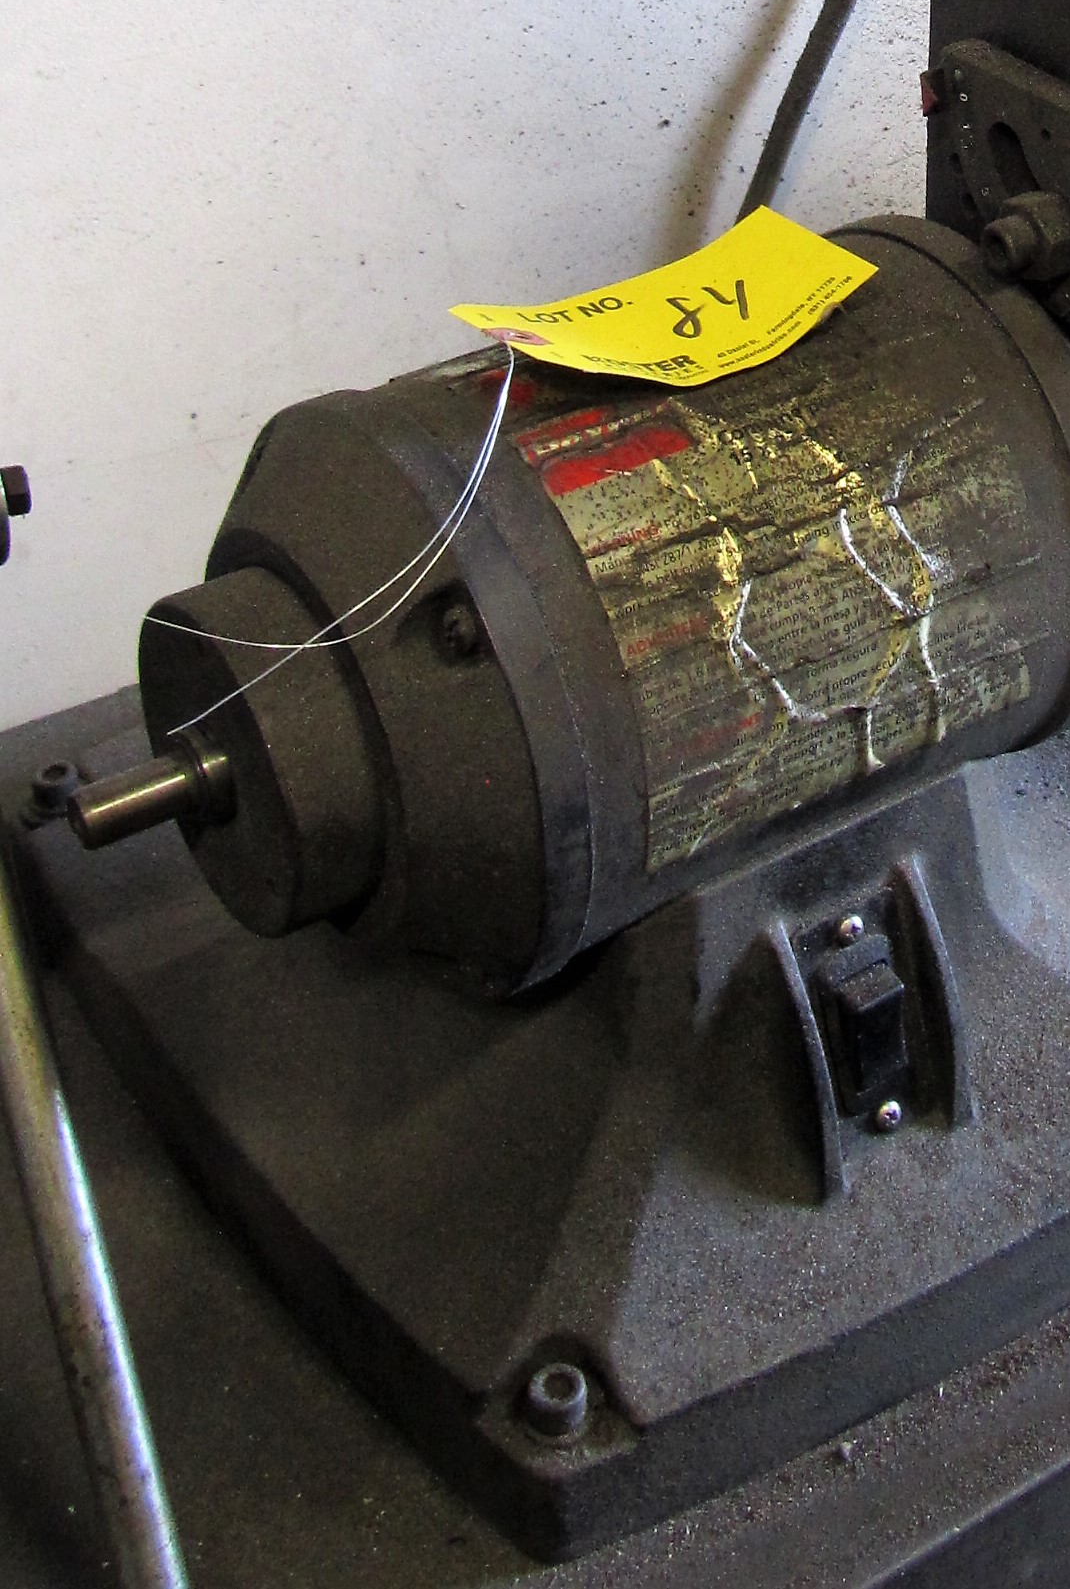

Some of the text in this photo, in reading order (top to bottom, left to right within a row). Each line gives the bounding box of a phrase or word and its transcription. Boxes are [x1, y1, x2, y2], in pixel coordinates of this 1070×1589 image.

[515, 296, 634, 324] LOT NO.
[727, 342, 750, 358] Daniel
